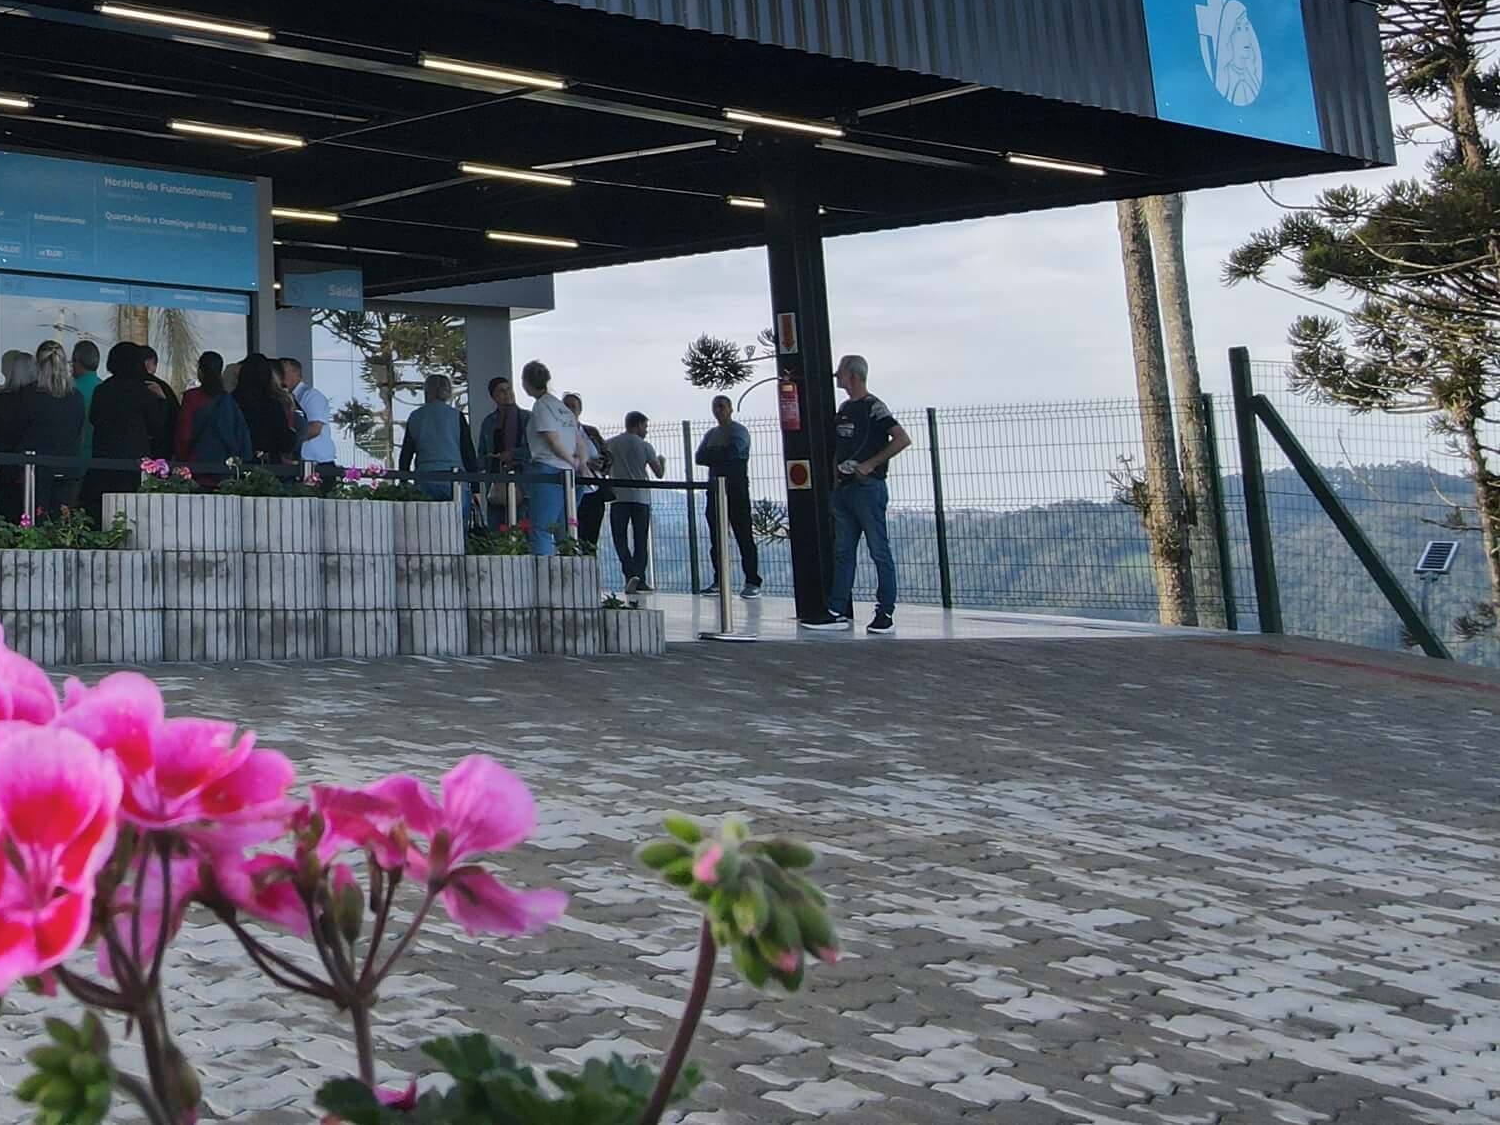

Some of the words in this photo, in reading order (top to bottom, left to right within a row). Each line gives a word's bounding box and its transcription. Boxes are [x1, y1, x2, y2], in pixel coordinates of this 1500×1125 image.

[104, 175, 144, 189] Horários
[146, 180, 159, 192] de
[160, 182, 233, 200] Funcionamento
